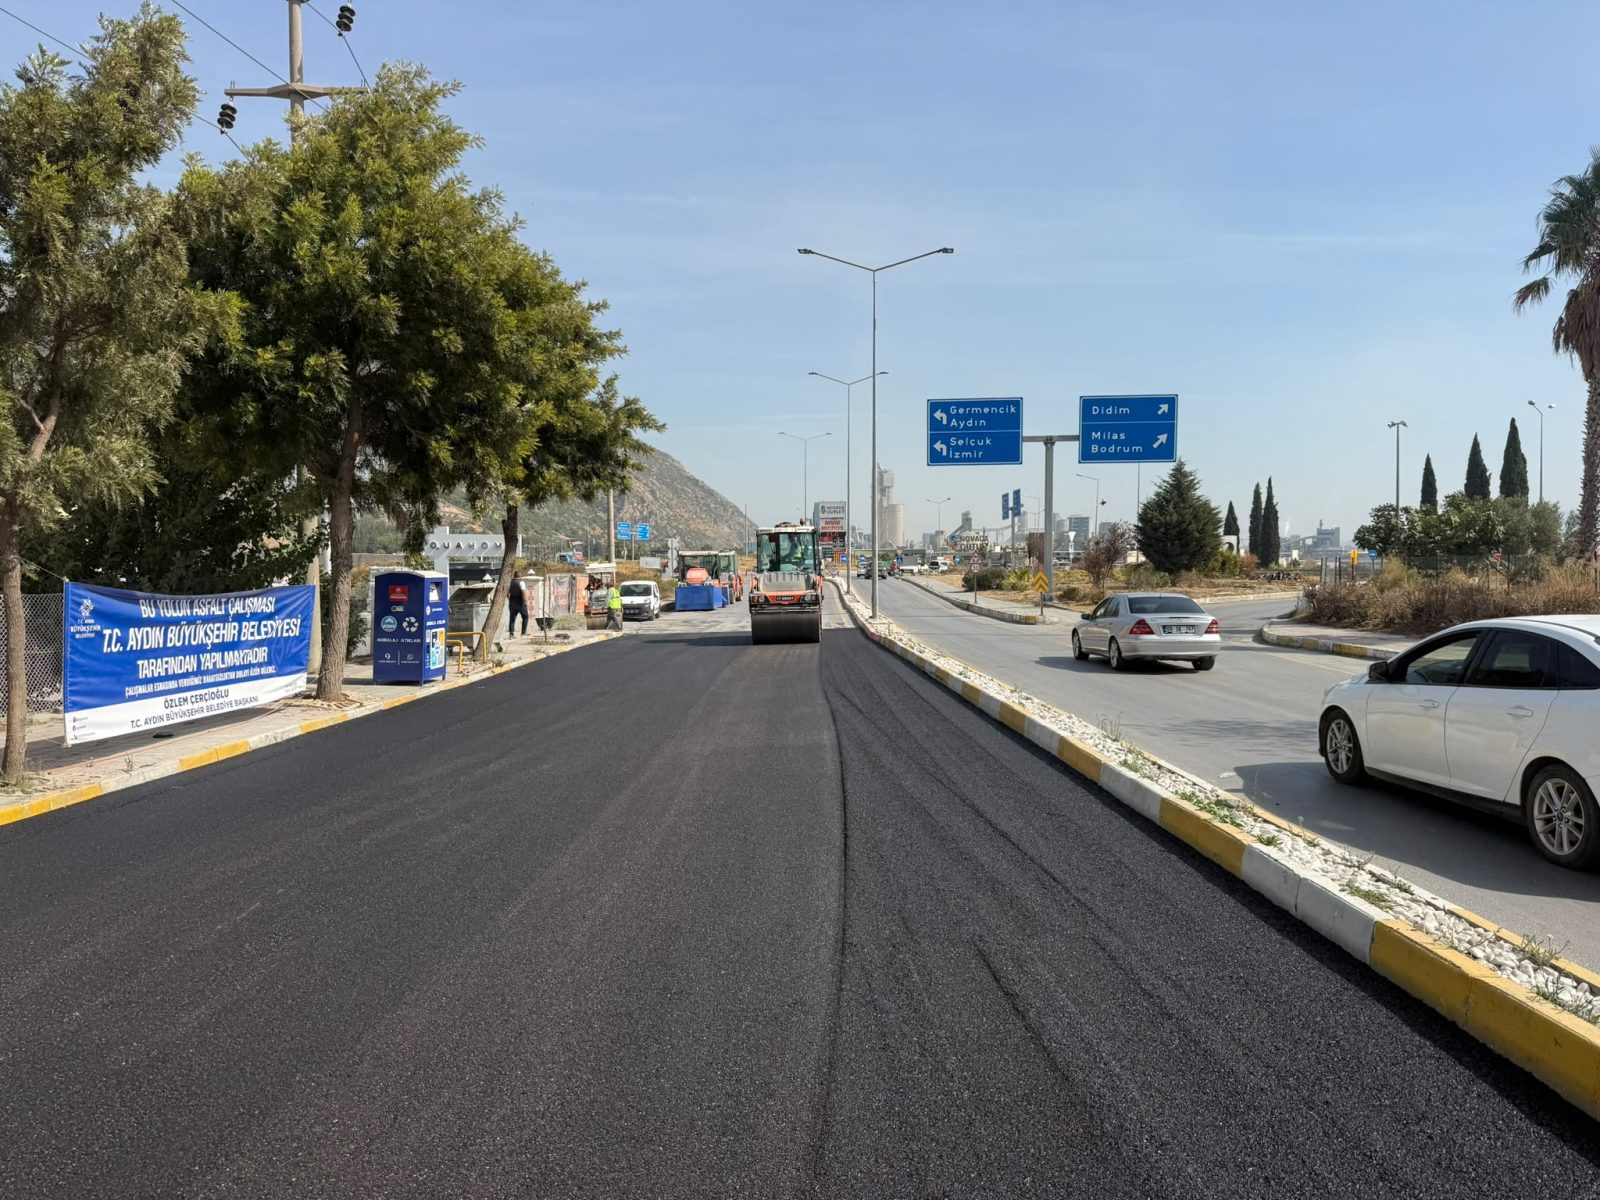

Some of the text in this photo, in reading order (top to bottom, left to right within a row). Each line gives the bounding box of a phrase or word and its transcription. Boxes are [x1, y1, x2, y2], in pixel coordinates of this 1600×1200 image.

[950, 404, 1016, 414] Germencik
[1092, 405, 1130, 415] Didim
[950, 418, 986, 429] Aydın
[950, 436, 992, 446] Selçuk
[1091, 431, 1126, 440] Milas
[949, 447, 983, 458] İzmir
[1091, 444, 1143, 453] Bodrum
[140, 597, 276, 618] BU YOLUN ASFALT ÇALIŞMASI
[103, 615, 301, 653] T.C. AYDIN BÜYÜKŞEHİR BELEDİYESİ
[137, 647, 268, 679] TARAFINDAN YAPILMAKTADIR
[164, 689, 230, 709] ÖZLEM ÇERÇİOĞLU
[131, 695, 259, 729] T.C. AYDIN BÜYÜKŞEHİR BELEDİYE BAŞKANI
